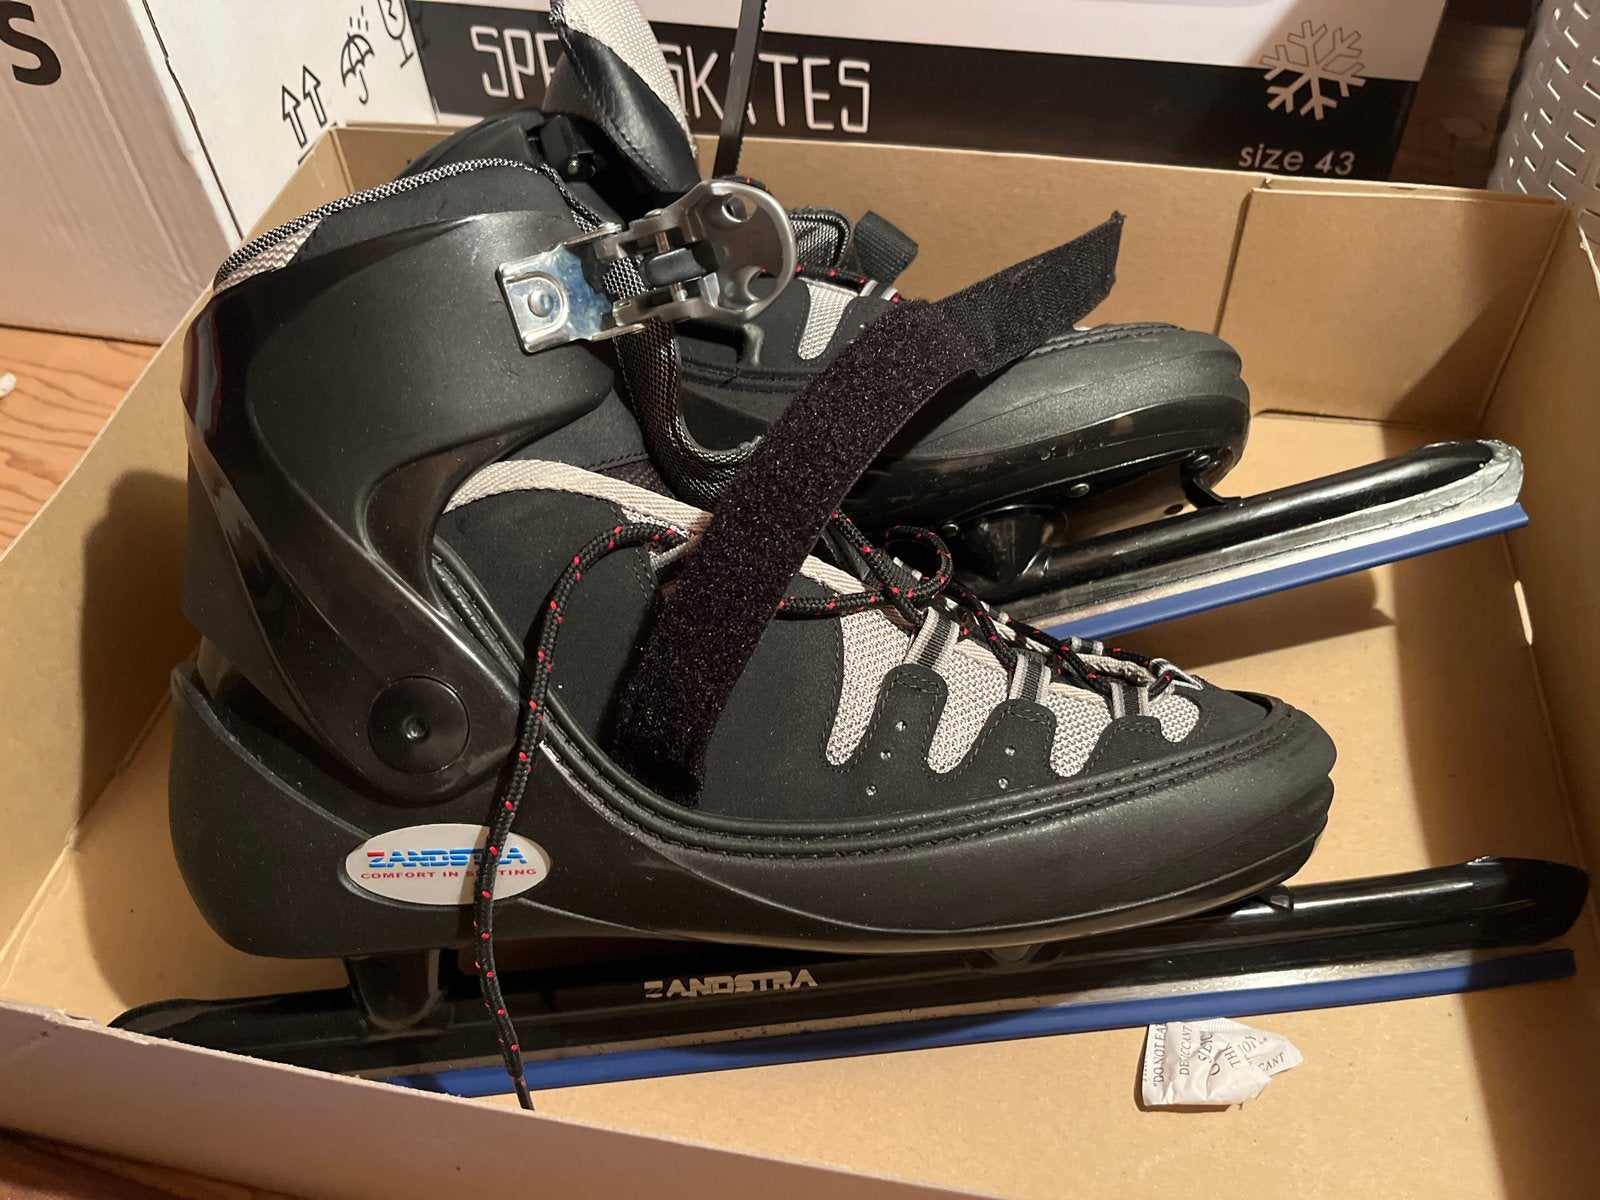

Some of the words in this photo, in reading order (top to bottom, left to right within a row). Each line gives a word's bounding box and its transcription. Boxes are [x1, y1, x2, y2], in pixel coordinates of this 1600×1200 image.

[469, 25, 871, 133] SPESKTES
[1238, 143, 1304, 171] size
[1315, 151, 1355, 175] 43
[367, 847, 528, 868] ZANDSTA
[360, 871, 435, 879] COMFORT
[442, 870, 459, 878] IN
[466, 869, 537, 878] STING
[644, 968, 818, 998] ZANDSTRA
[1154, 1042, 1165, 1064] NOT
